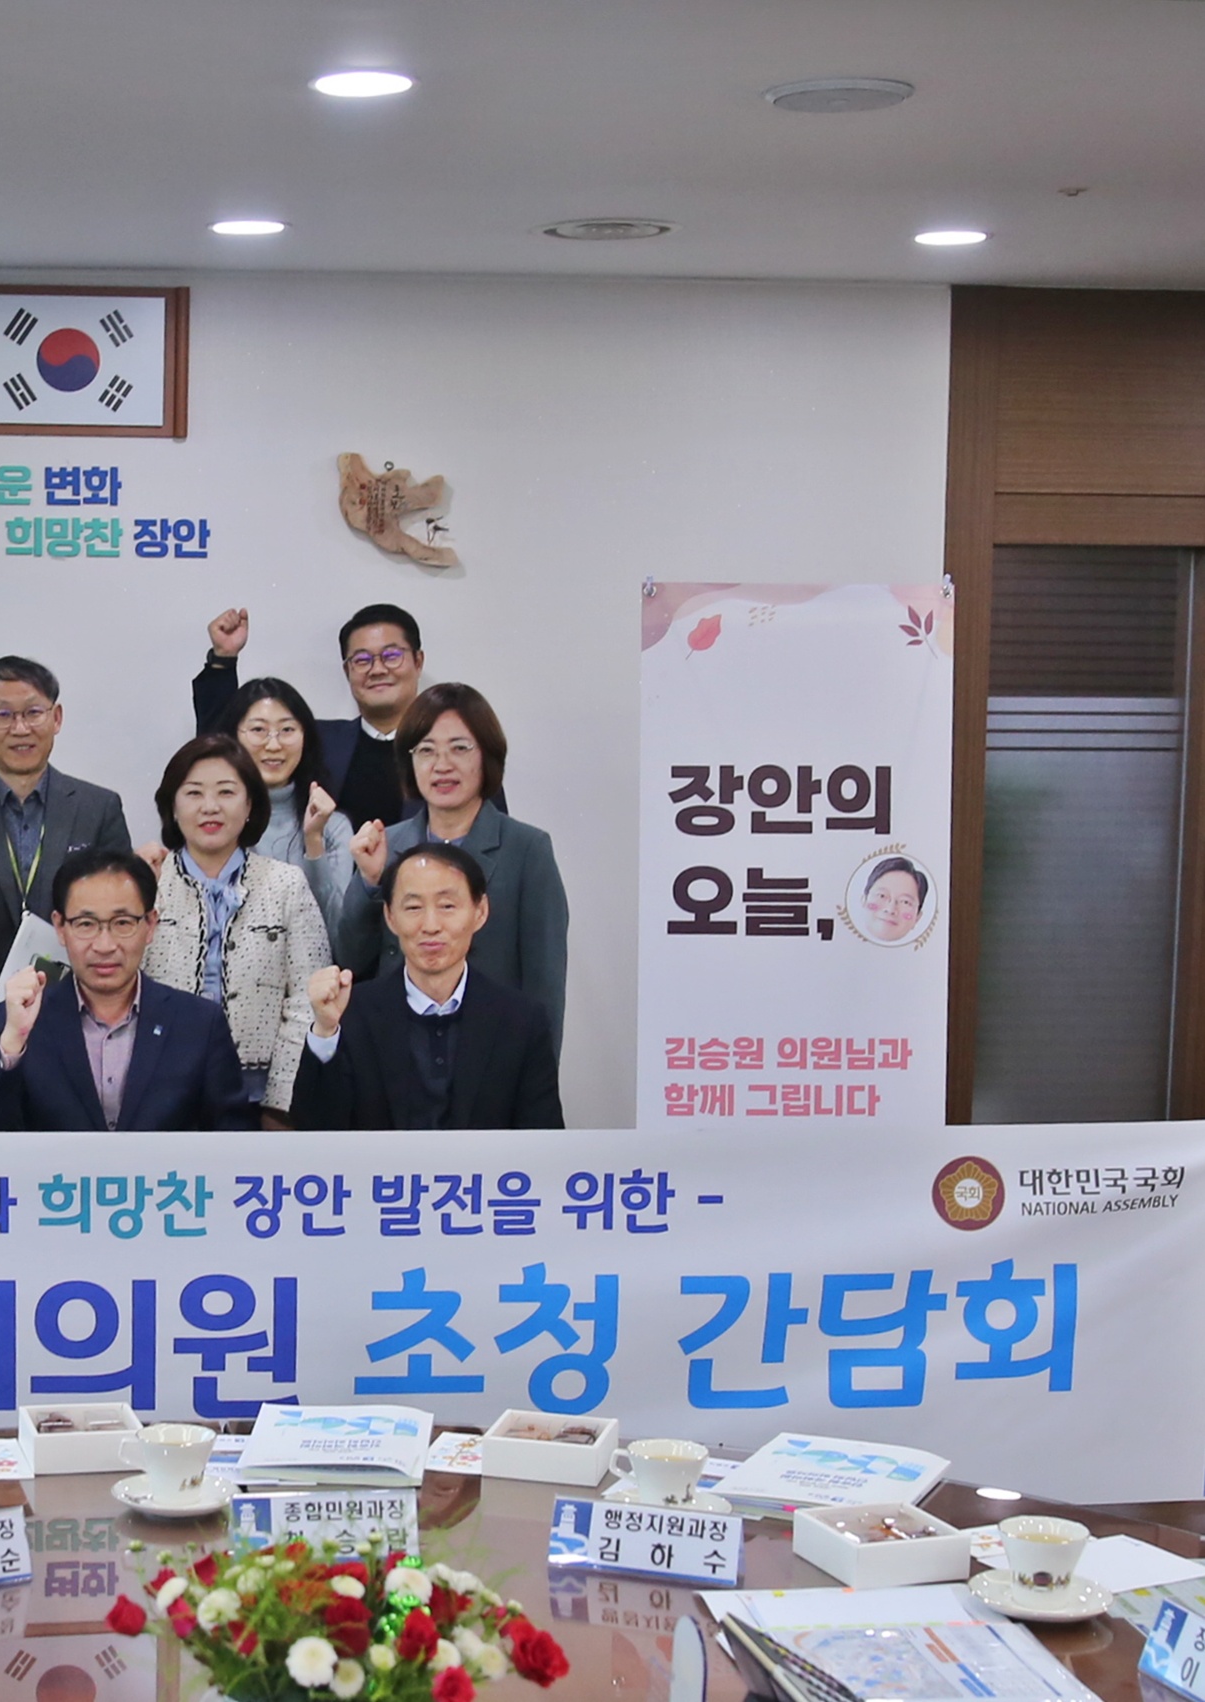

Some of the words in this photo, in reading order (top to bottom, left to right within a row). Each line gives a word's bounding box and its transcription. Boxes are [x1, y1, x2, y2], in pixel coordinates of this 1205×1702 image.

[44, 466, 122, 506] 변화
[5, 517, 123, 558] 희망찬
[133, 518, 211, 558] 장안
[668, 764, 892, 837] 장안의
[667, 864, 835, 941] 오늘,
[664, 1036, 765, 1071] 김승원
[777, 1036, 913, 1071] 의원님과
[664, 1082, 734, 1117] 함께
[745, 1083, 881, 1117] 그립니다
[955, 1185, 981, 1201] 국회
[1019, 1167, 1129, 1197] 대한민국
[1133, 1166, 1186, 1193] 국회
[38, 1170, 214, 1240] 희망찬
[233, 1173, 351, 1240] 장안
[372, 1170, 542, 1237] 발전을
[562, 1168, 675, 1234] 위한
[1021, 1201, 1098, 1217] NATIONAL
[1102, 1194, 1179, 1214] ASSEMBLY
[354, 1262, 620, 1416] 초청
[677, 1258, 1078, 1411] 간담회
[284, 1498, 406, 1523] 종합민원과장
[604, 1508, 728, 1543] 행정지원과장
